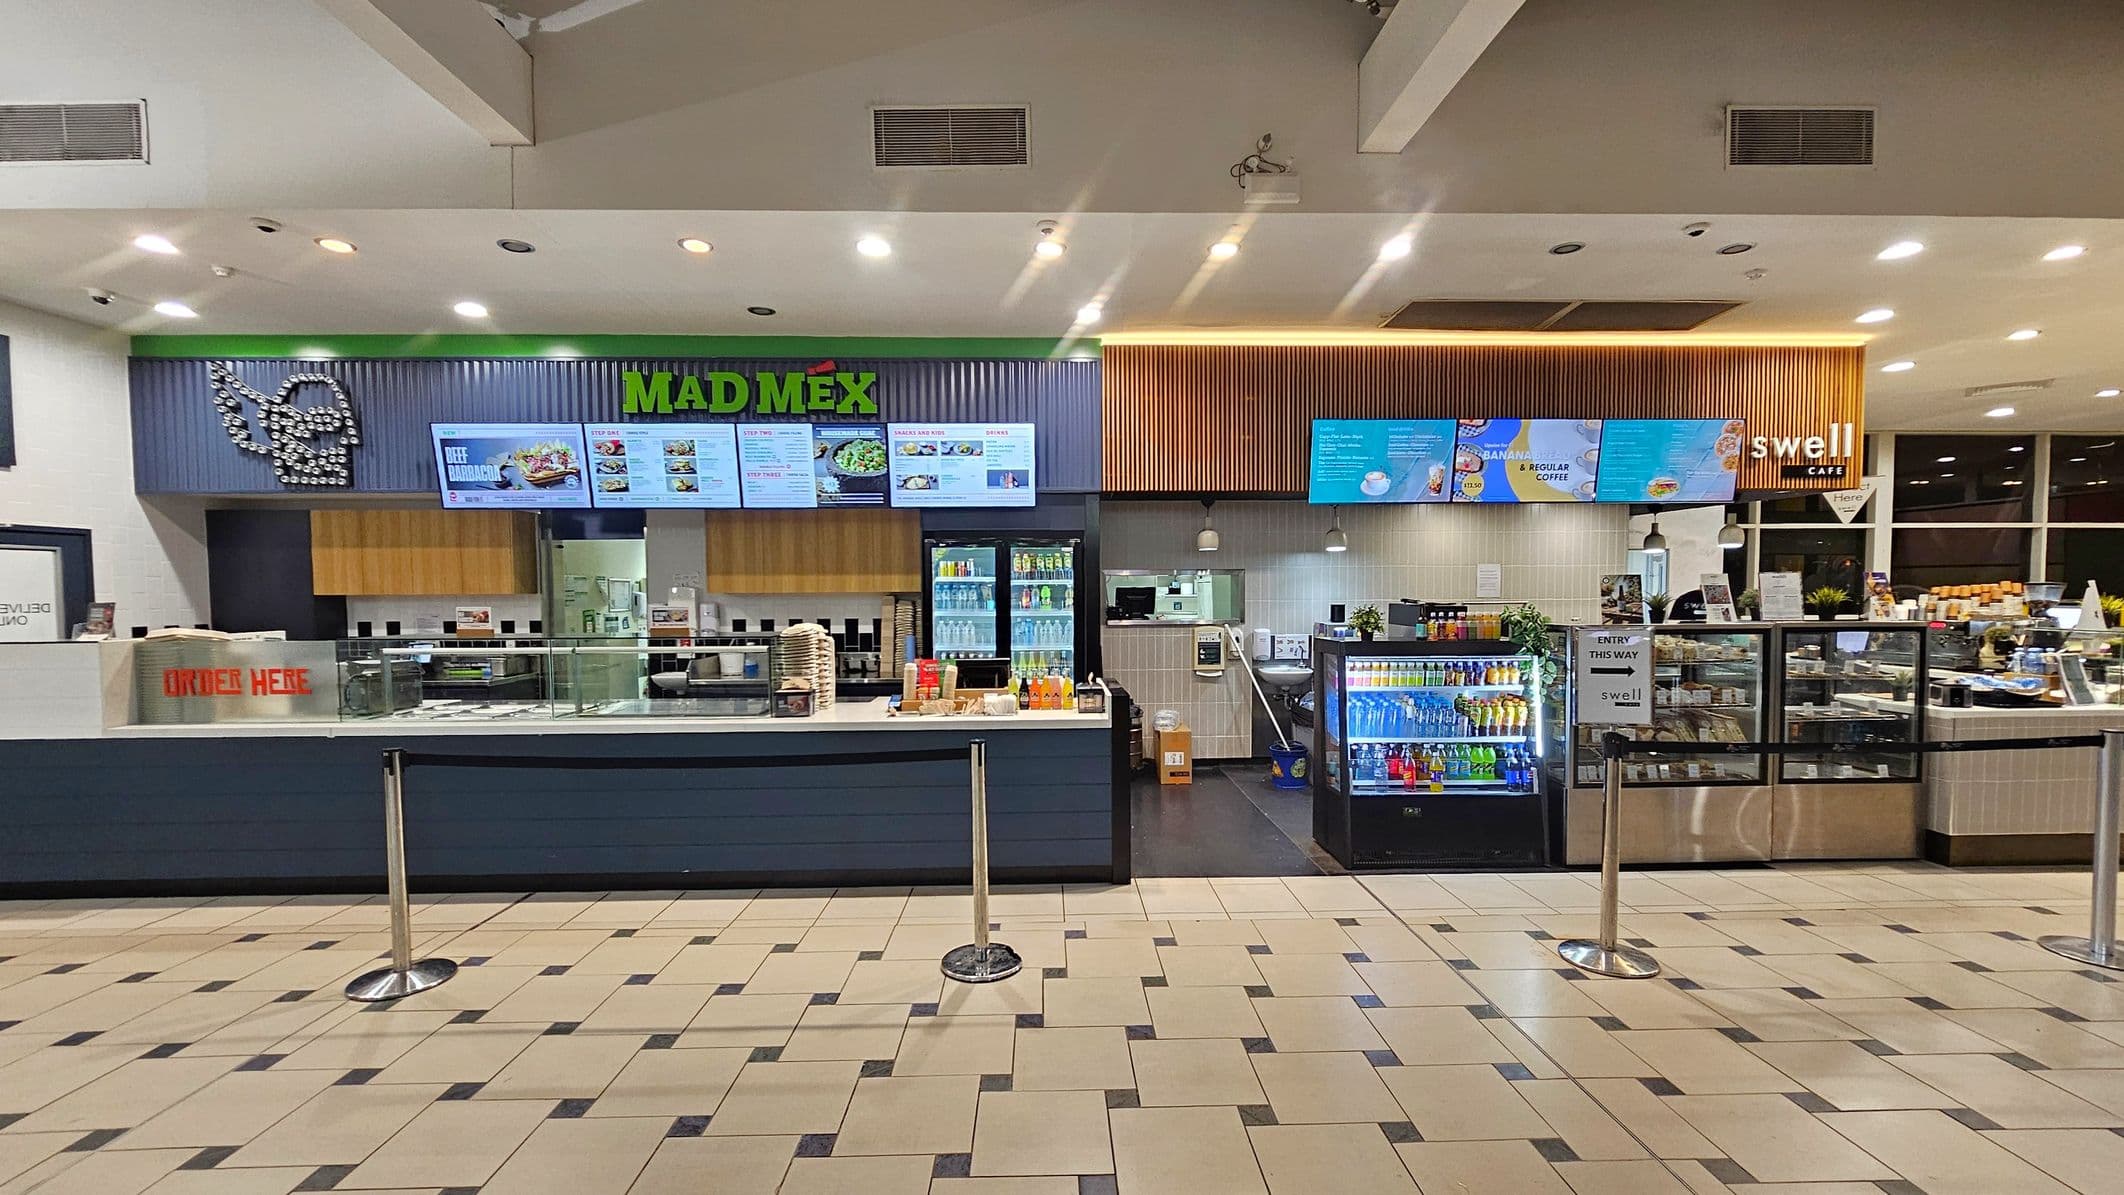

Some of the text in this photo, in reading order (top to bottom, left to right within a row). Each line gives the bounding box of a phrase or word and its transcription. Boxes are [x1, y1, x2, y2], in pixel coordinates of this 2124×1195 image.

[622, 371, 749, 414] MAD
[1750, 422, 1853, 459] swell
[444, 446, 468, 464] BEEF
[1483, 450, 1532, 460] BANANA
[1519, 463, 1570, 472] & REGULAR
[1807, 466, 1844, 476] CAFE
[448, 465, 502, 482] BARBACOA
[1535, 473, 1569, 481] COFFEE
[1833, 492, 1863, 502] Here
[1597, 636, 1631, 645] ENTRY
[1589, 651, 1639, 660] THIS WAY
[163, 668, 313, 697] ORDER HERE
[1601, 687, 1641, 701] swell
